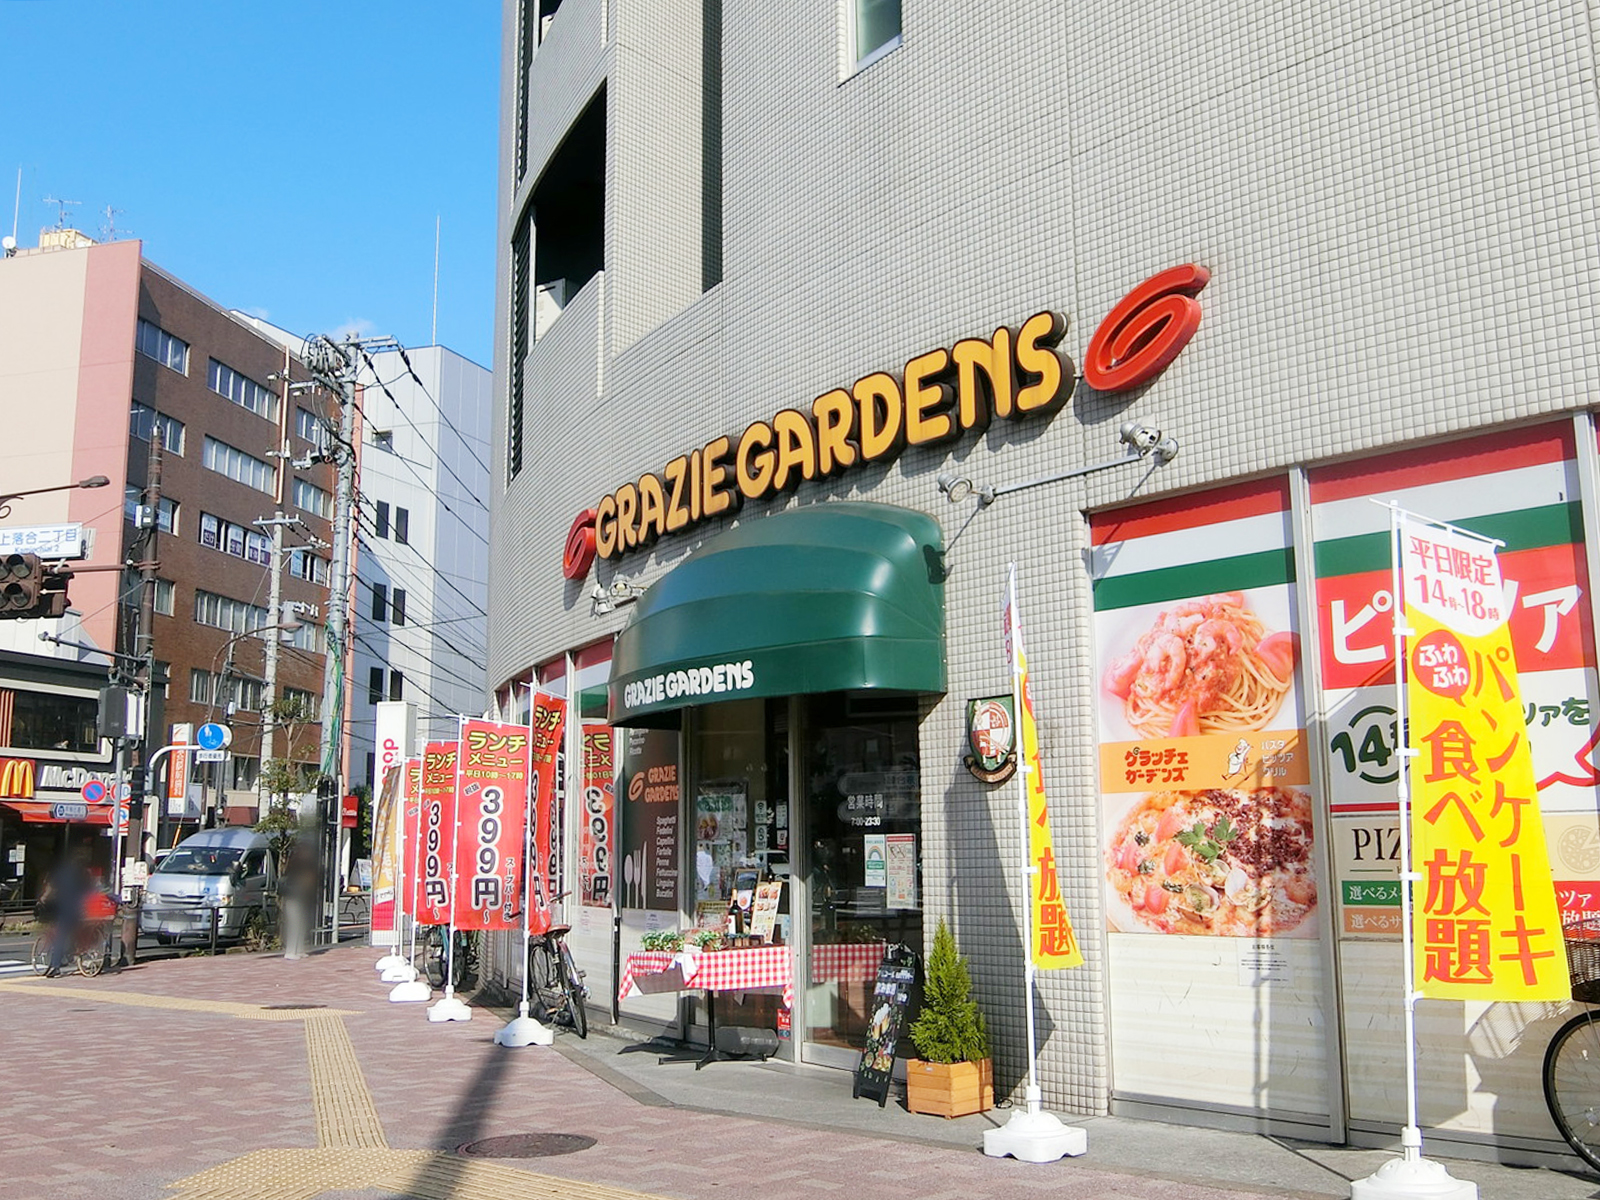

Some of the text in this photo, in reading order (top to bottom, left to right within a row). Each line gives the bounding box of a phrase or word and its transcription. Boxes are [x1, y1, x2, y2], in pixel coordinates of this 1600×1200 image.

[596, 311, 1070, 560] GRAZIE GARDENS
[0, 528, 77, 546] 上落合二丁目
[1410, 536, 1496, 586] 平日限定
[1418, 642, 1459, 668] ふわ
[624, 660, 754, 708] GRAZIE GARDENS
[1432, 664, 1468, 688] ふわ
[534, 705, 562, 731] ランチ
[468, 731, 527, 753] ランチ
[427, 752, 457, 770] ランチ
[468, 752, 524, 768] メニュー
[1125, 746, 1188, 767] グラッチェ
[425, 773, 454, 784] メニュー
[648, 765, 677, 784] GRAZIE
[1126, 766, 1188, 784] ガーデンズ
[848, 794, 883, 809] 営業時間
[1472, 646, 1556, 986] パンケーキ
[1421, 720, 1494, 985] 食べ放題
